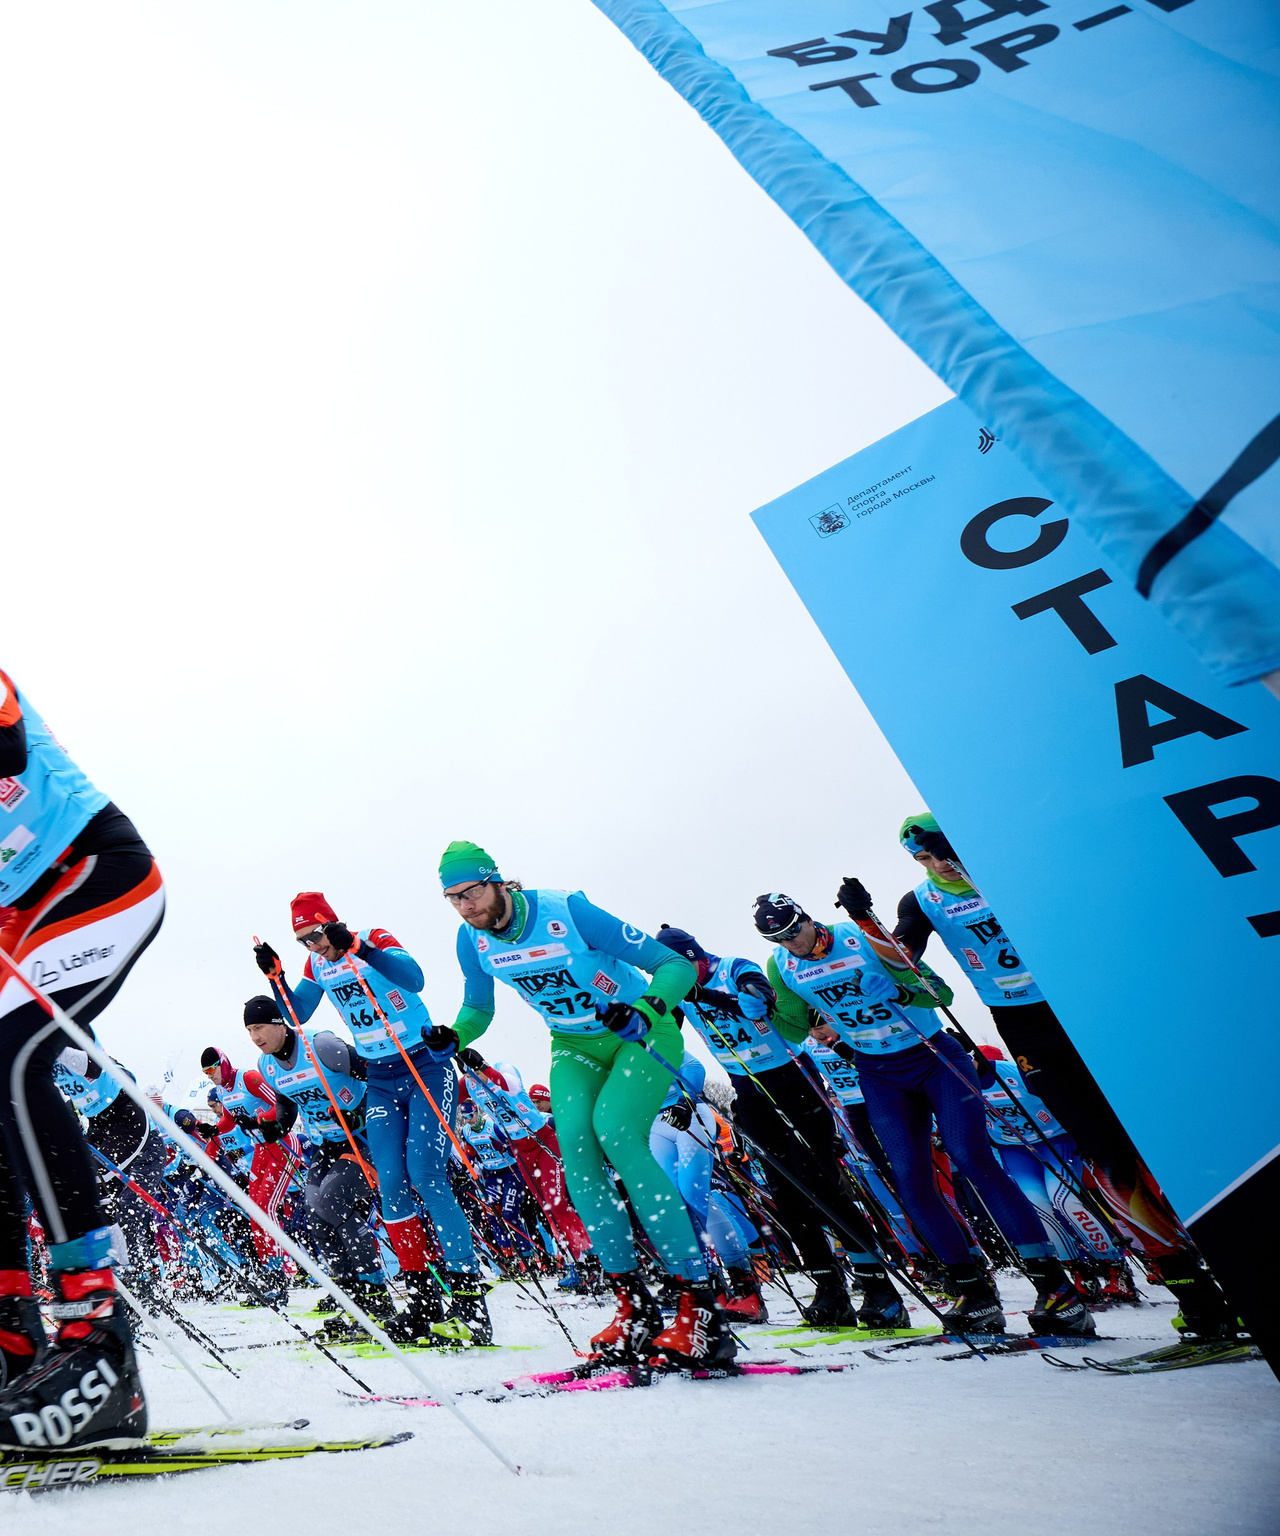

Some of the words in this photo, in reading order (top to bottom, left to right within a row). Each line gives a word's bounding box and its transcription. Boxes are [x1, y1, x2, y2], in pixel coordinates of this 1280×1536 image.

[847, 465, 913, 506] Департамент
[856, 497, 892, 519] города
[892, 474, 936, 500] Москвы
[851, 490, 887, 511] спорта
[960, 496, 1280, 938] СТАР
[953, 901, 980, 913] MAER
[500, 954, 523, 964] MAER
[997, 946, 1020, 969] 6
[512, 968, 582, 997] TOPSKI
[803, 968, 824, 979] MAER
[539, 991, 595, 1016] 272
[840, 999, 864, 1008] FAMILY
[836, 1003, 893, 1028] 565
[709, 1027, 753, 1049] 584
[574, 1055, 601, 1072] SKI
[434, 1066, 457, 1158] PROSPORT
[969, 1306, 999, 1318] SALOMON
[1057, 1338, 1086, 1346] salomon
[10, 1358, 119, 1446] ROSSI
